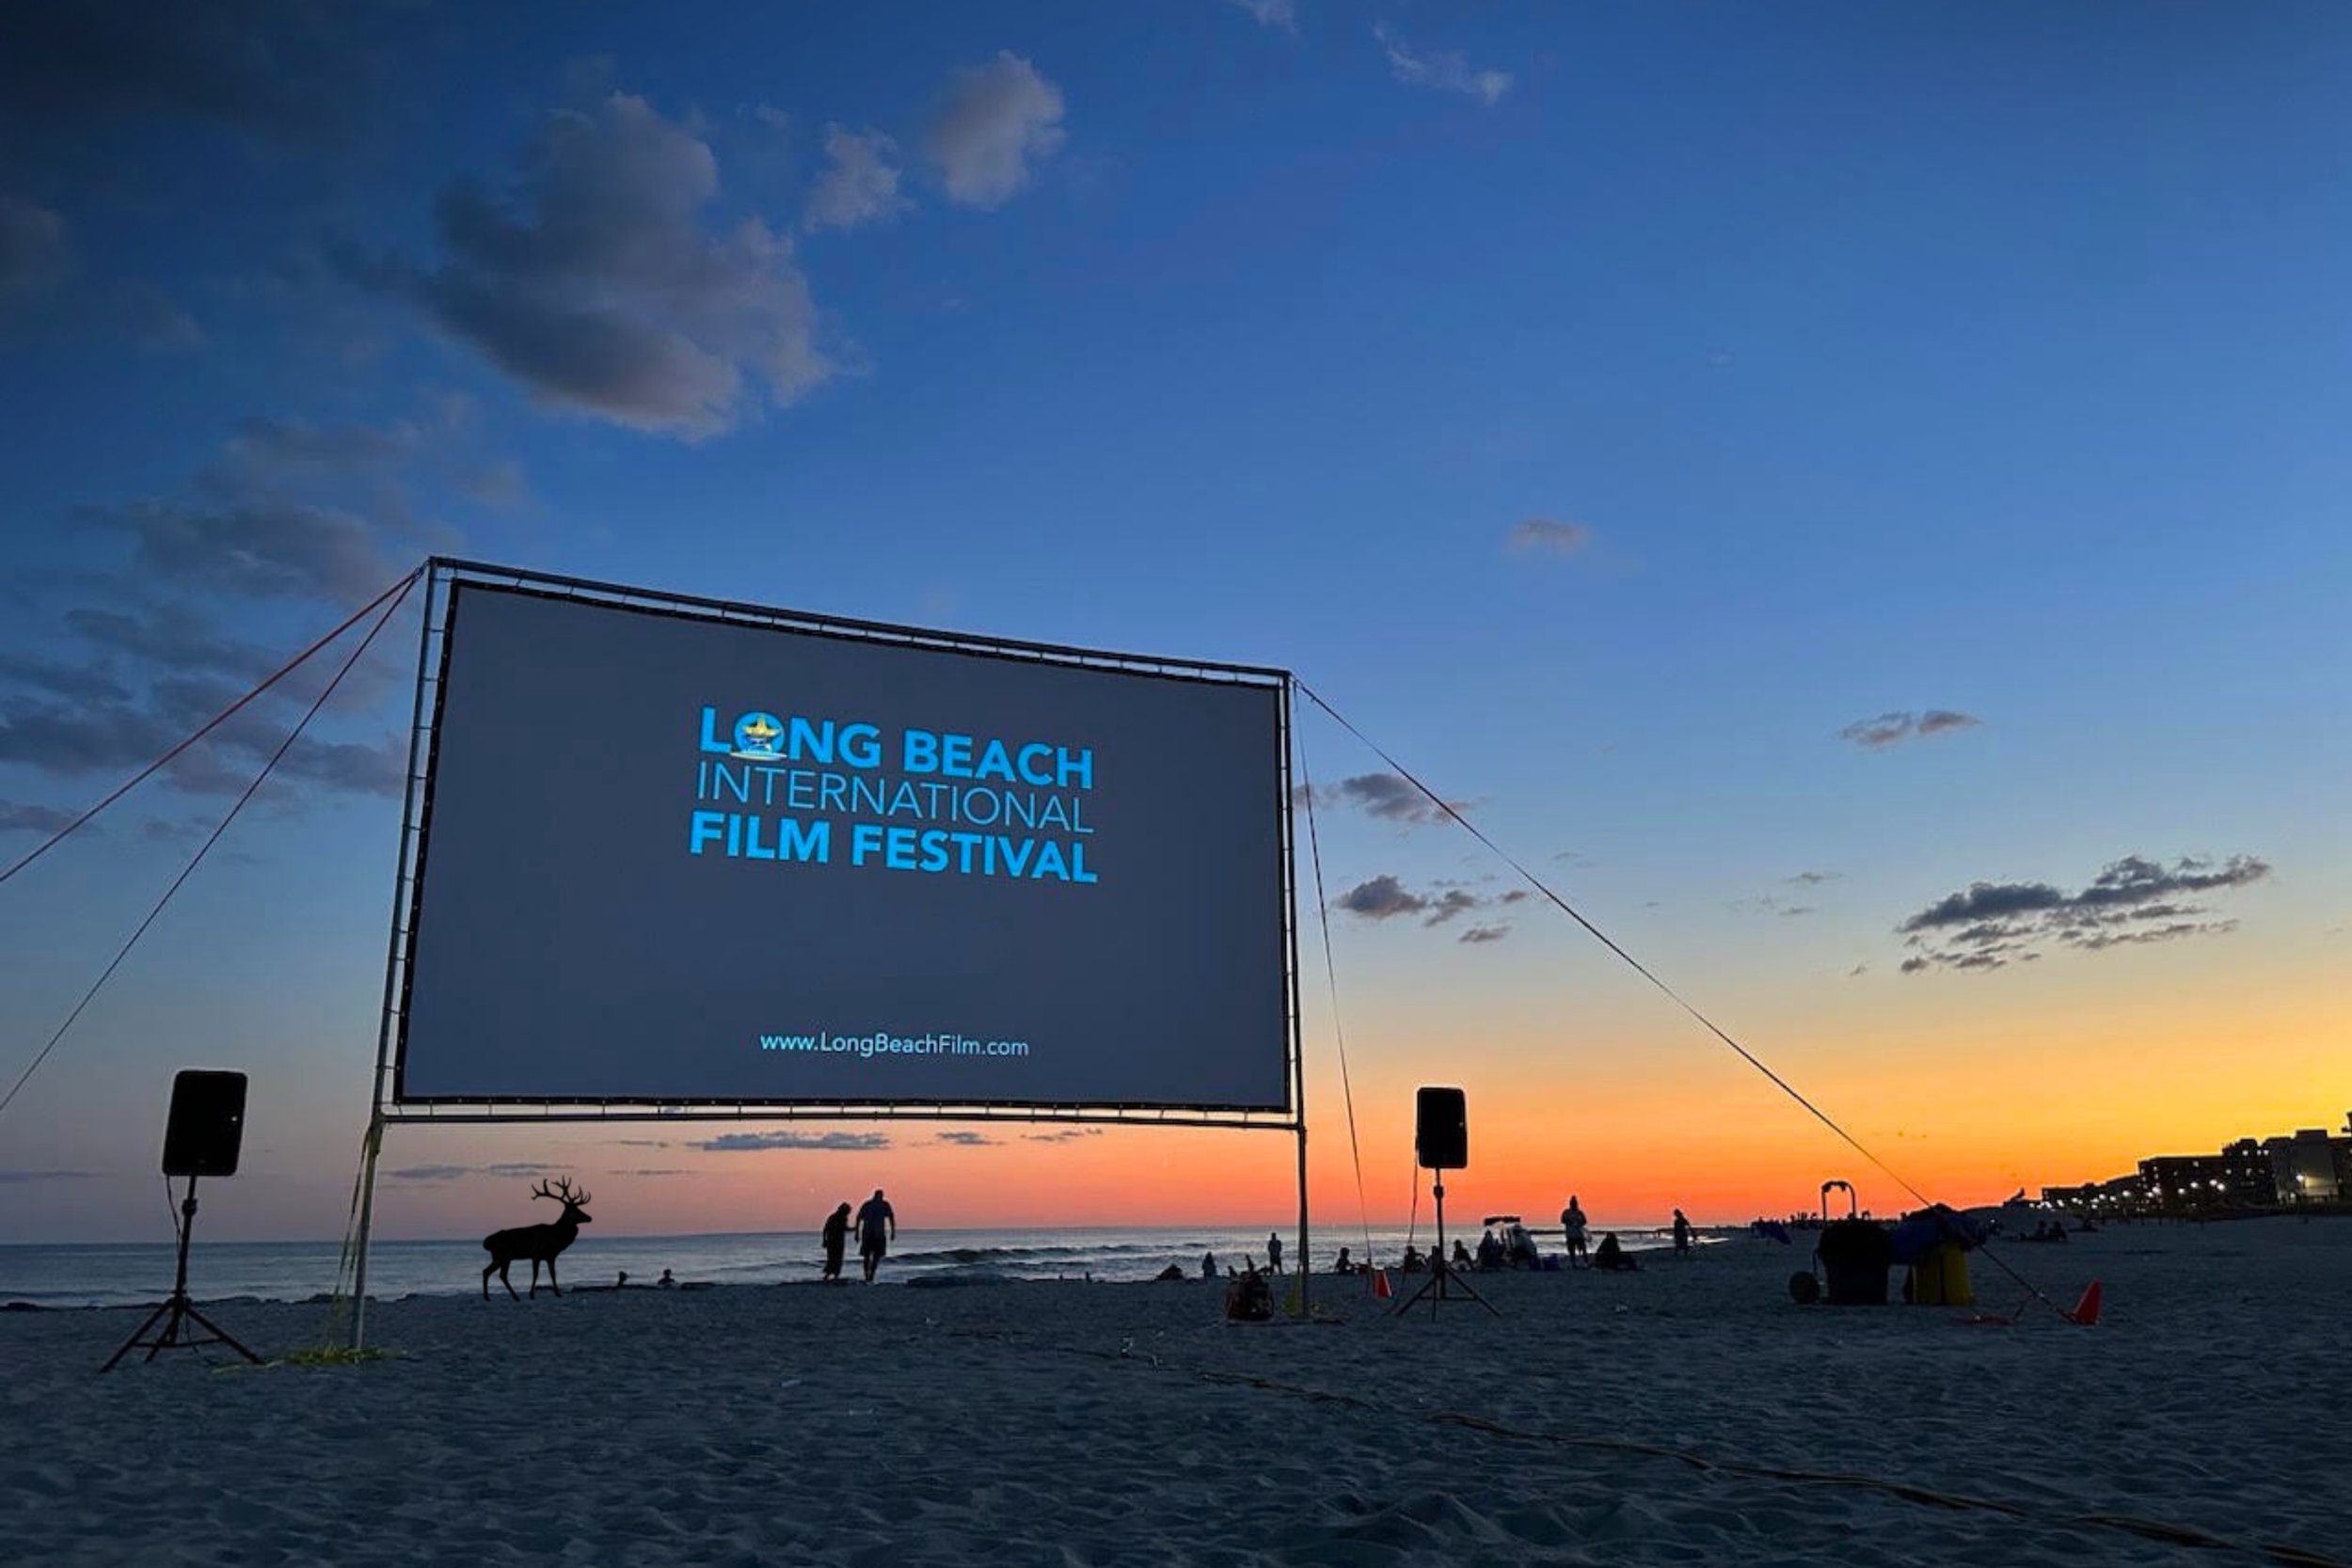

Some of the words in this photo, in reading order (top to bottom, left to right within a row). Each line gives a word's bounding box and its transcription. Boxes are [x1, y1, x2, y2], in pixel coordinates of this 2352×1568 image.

[700, 706, 881, 768] LONG
[904, 730, 1092, 789] BEACH
[697, 761, 1094, 833] INTERNATIONAL
[690, 810, 831, 864] FILM
[851, 824, 1099, 883] FESTIVAL
[760, 1032, 1029, 1057] www.LongBeachFilm.com
